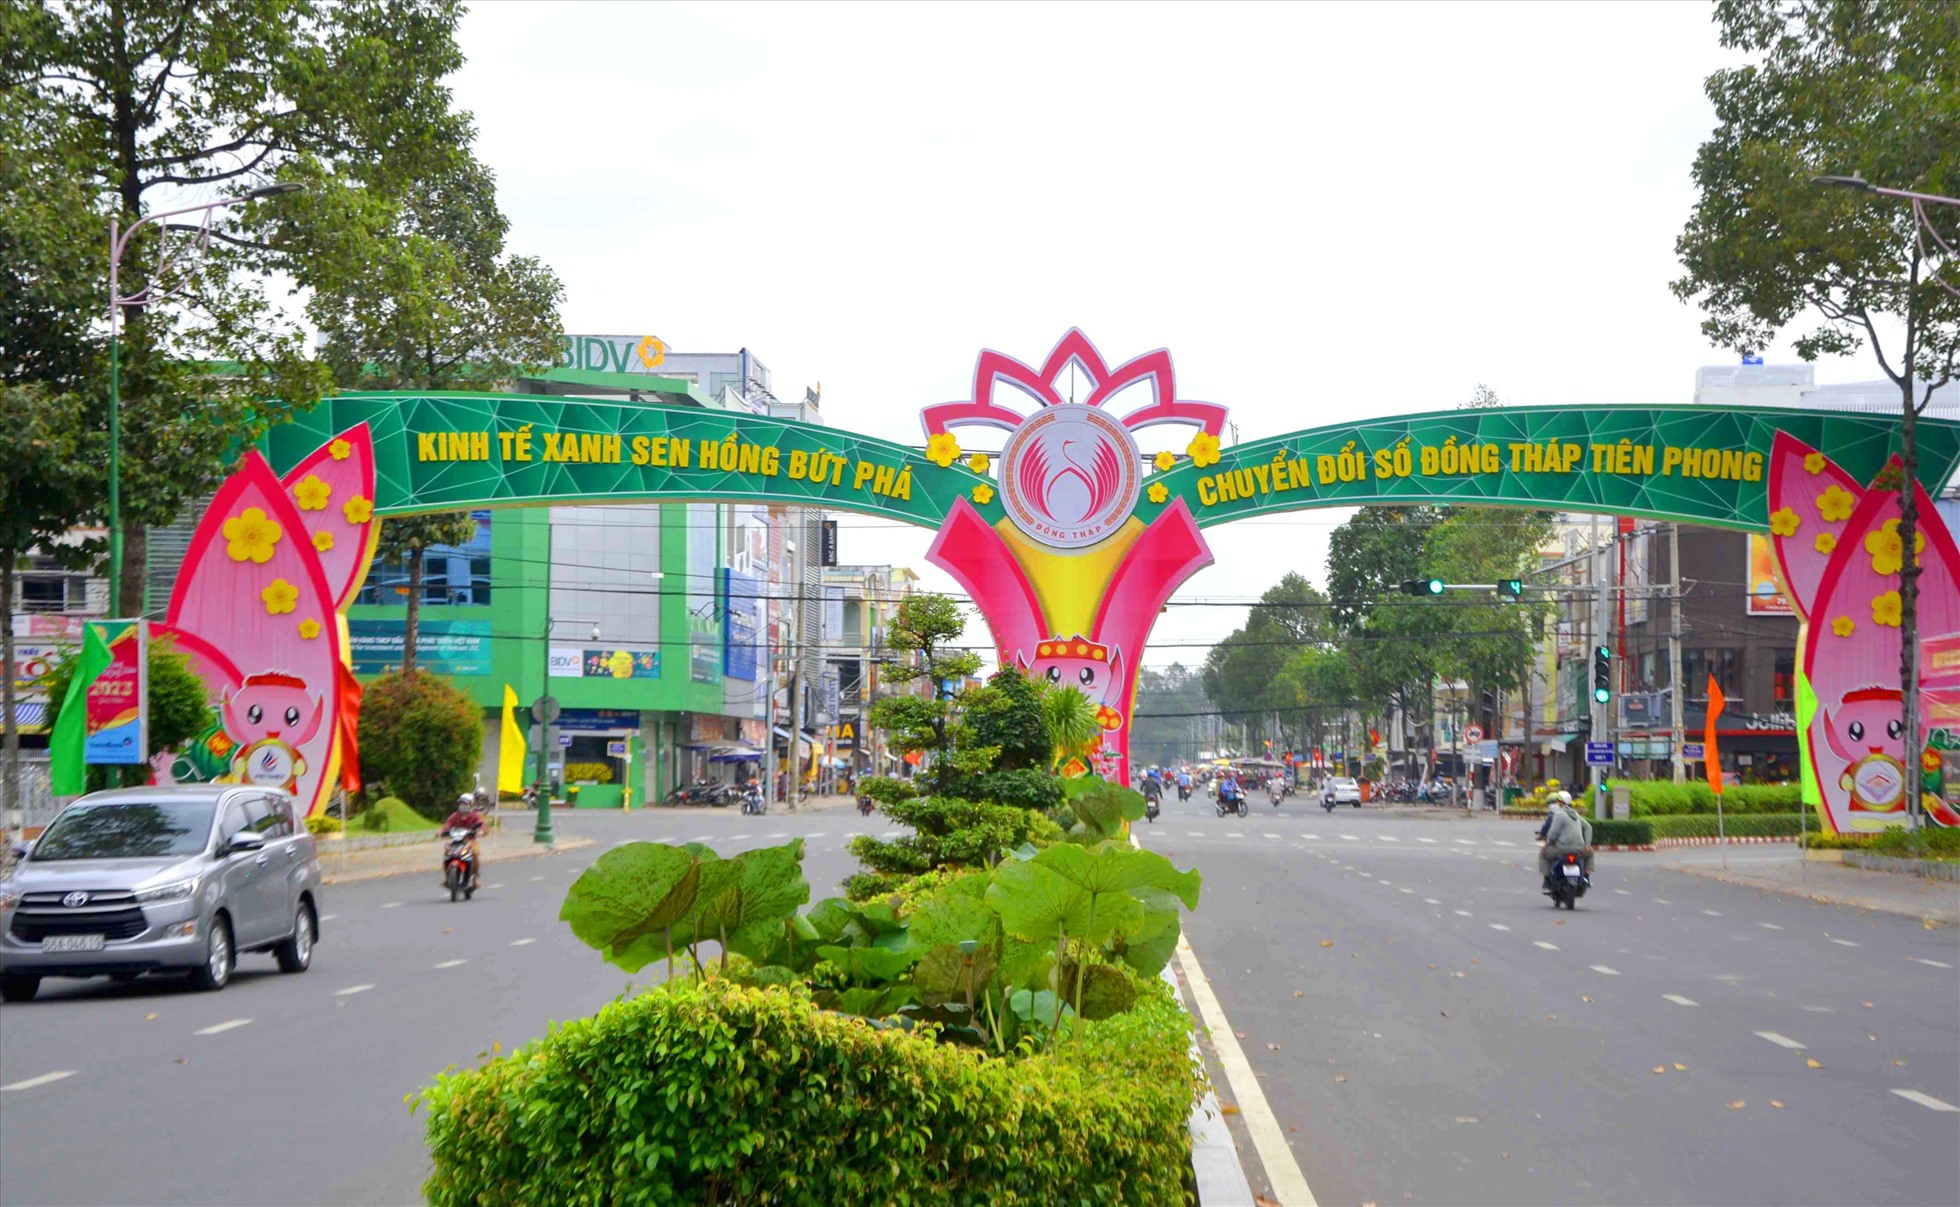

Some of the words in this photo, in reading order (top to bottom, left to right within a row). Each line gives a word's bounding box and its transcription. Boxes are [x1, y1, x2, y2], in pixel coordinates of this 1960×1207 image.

[558, 335, 635, 374] BIDV
[417, 431, 490, 462] KINH
[498, 423, 535, 462] TẾ
[542, 432, 621, 464] XANH
[632, 435, 690, 468] SEN
[700, 432, 780, 477] HỒNG
[788, 447, 848, 487] BỨT
[853, 465, 913, 501] PHÁ
[1197, 449, 1310, 506] CHUYỂN
[1317, 440, 1367, 485] ĐỔI
[1374, 436, 1413, 480] SỐ
[1420, 435, 1500, 477] ĐỒNG
[1508, 437, 1583, 473] THÁP
[1590, 438, 1655, 476] TIÊN
[1663, 446, 1764, 482] PHONG
[1072, 525, 1102, 539] THÁP
[1510, 581, 1520, 594] 4
[550, 656, 572, 667] BIDV
[89, 681, 134, 696] 2023
